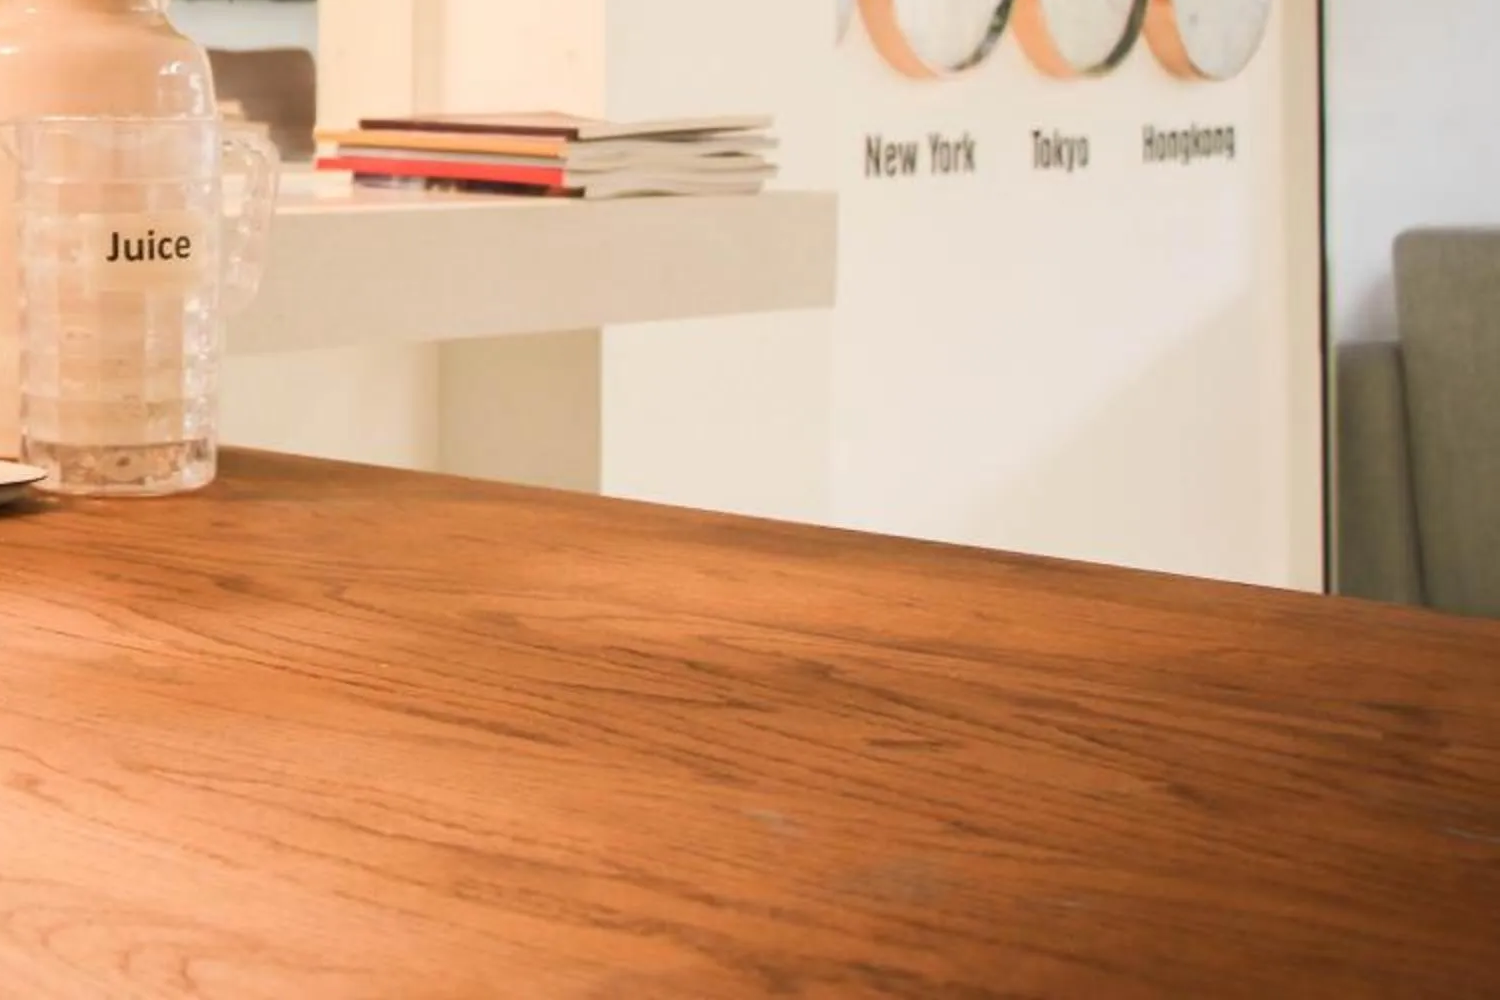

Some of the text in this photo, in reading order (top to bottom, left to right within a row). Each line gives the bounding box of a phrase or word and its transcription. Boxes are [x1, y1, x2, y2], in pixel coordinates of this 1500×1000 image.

[864, 131, 977, 177] New York
[1031, 128, 1091, 172] Tokyo
[106, 229, 191, 262] Juice
